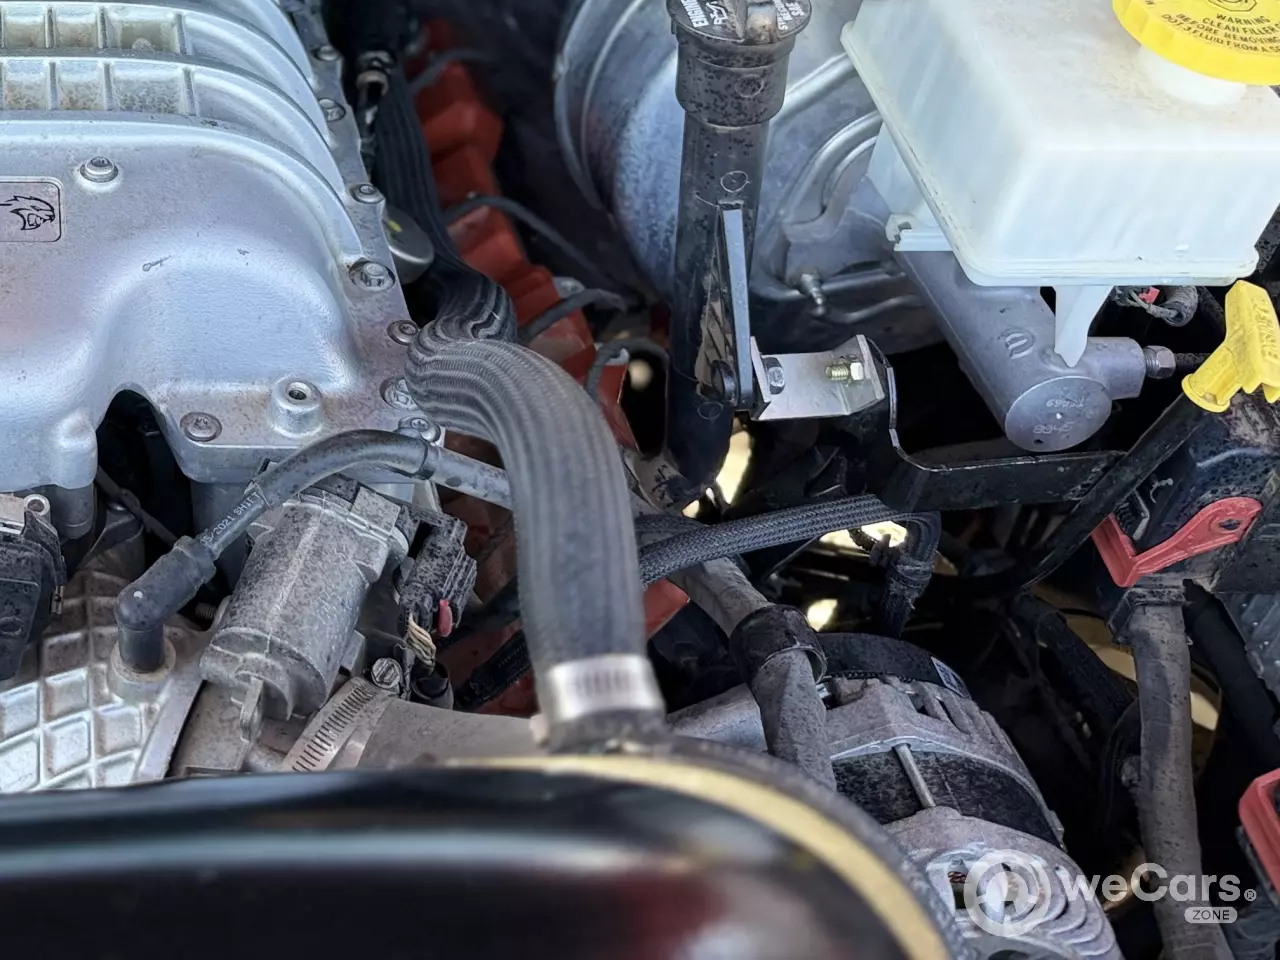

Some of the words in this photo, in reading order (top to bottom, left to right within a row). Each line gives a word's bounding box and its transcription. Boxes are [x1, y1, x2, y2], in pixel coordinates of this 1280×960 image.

[1161, 14, 1184, 27] DOT
[1176, 14, 1220, 35] BEFORE
[1202, 17, 1240, 34] CLEAN
[1242, 23, 1279, 36] FILLER
[1216, 12, 1271, 26] WARNING
[233, 491, 261, 516] SHIFT
